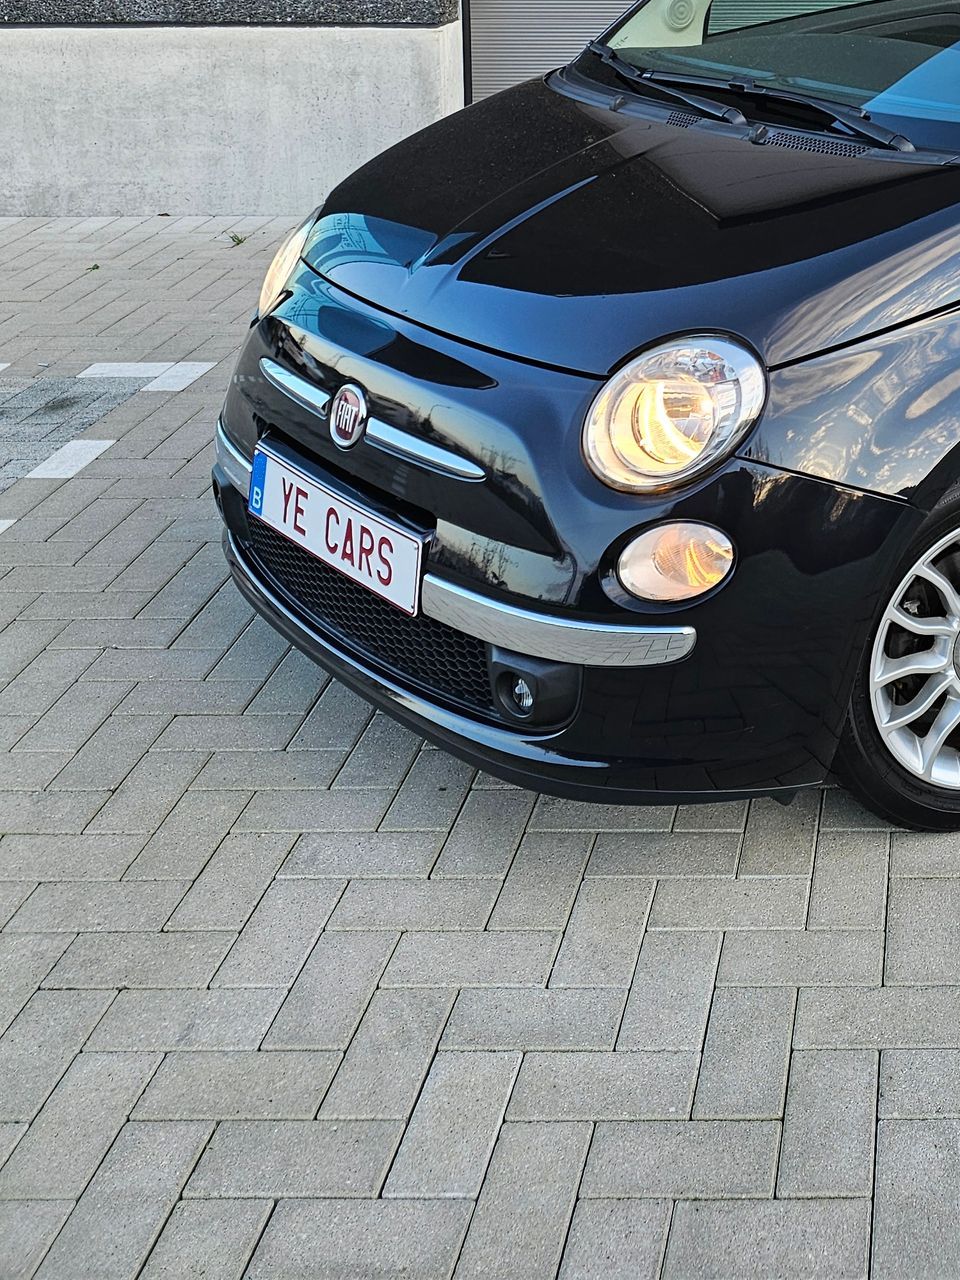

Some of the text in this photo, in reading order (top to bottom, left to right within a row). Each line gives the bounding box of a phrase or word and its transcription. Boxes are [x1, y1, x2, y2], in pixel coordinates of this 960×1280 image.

[336, 400, 359, 433] FIAT
[252, 486, 262, 509] B
[281, 476, 394, 587] YE CARS
